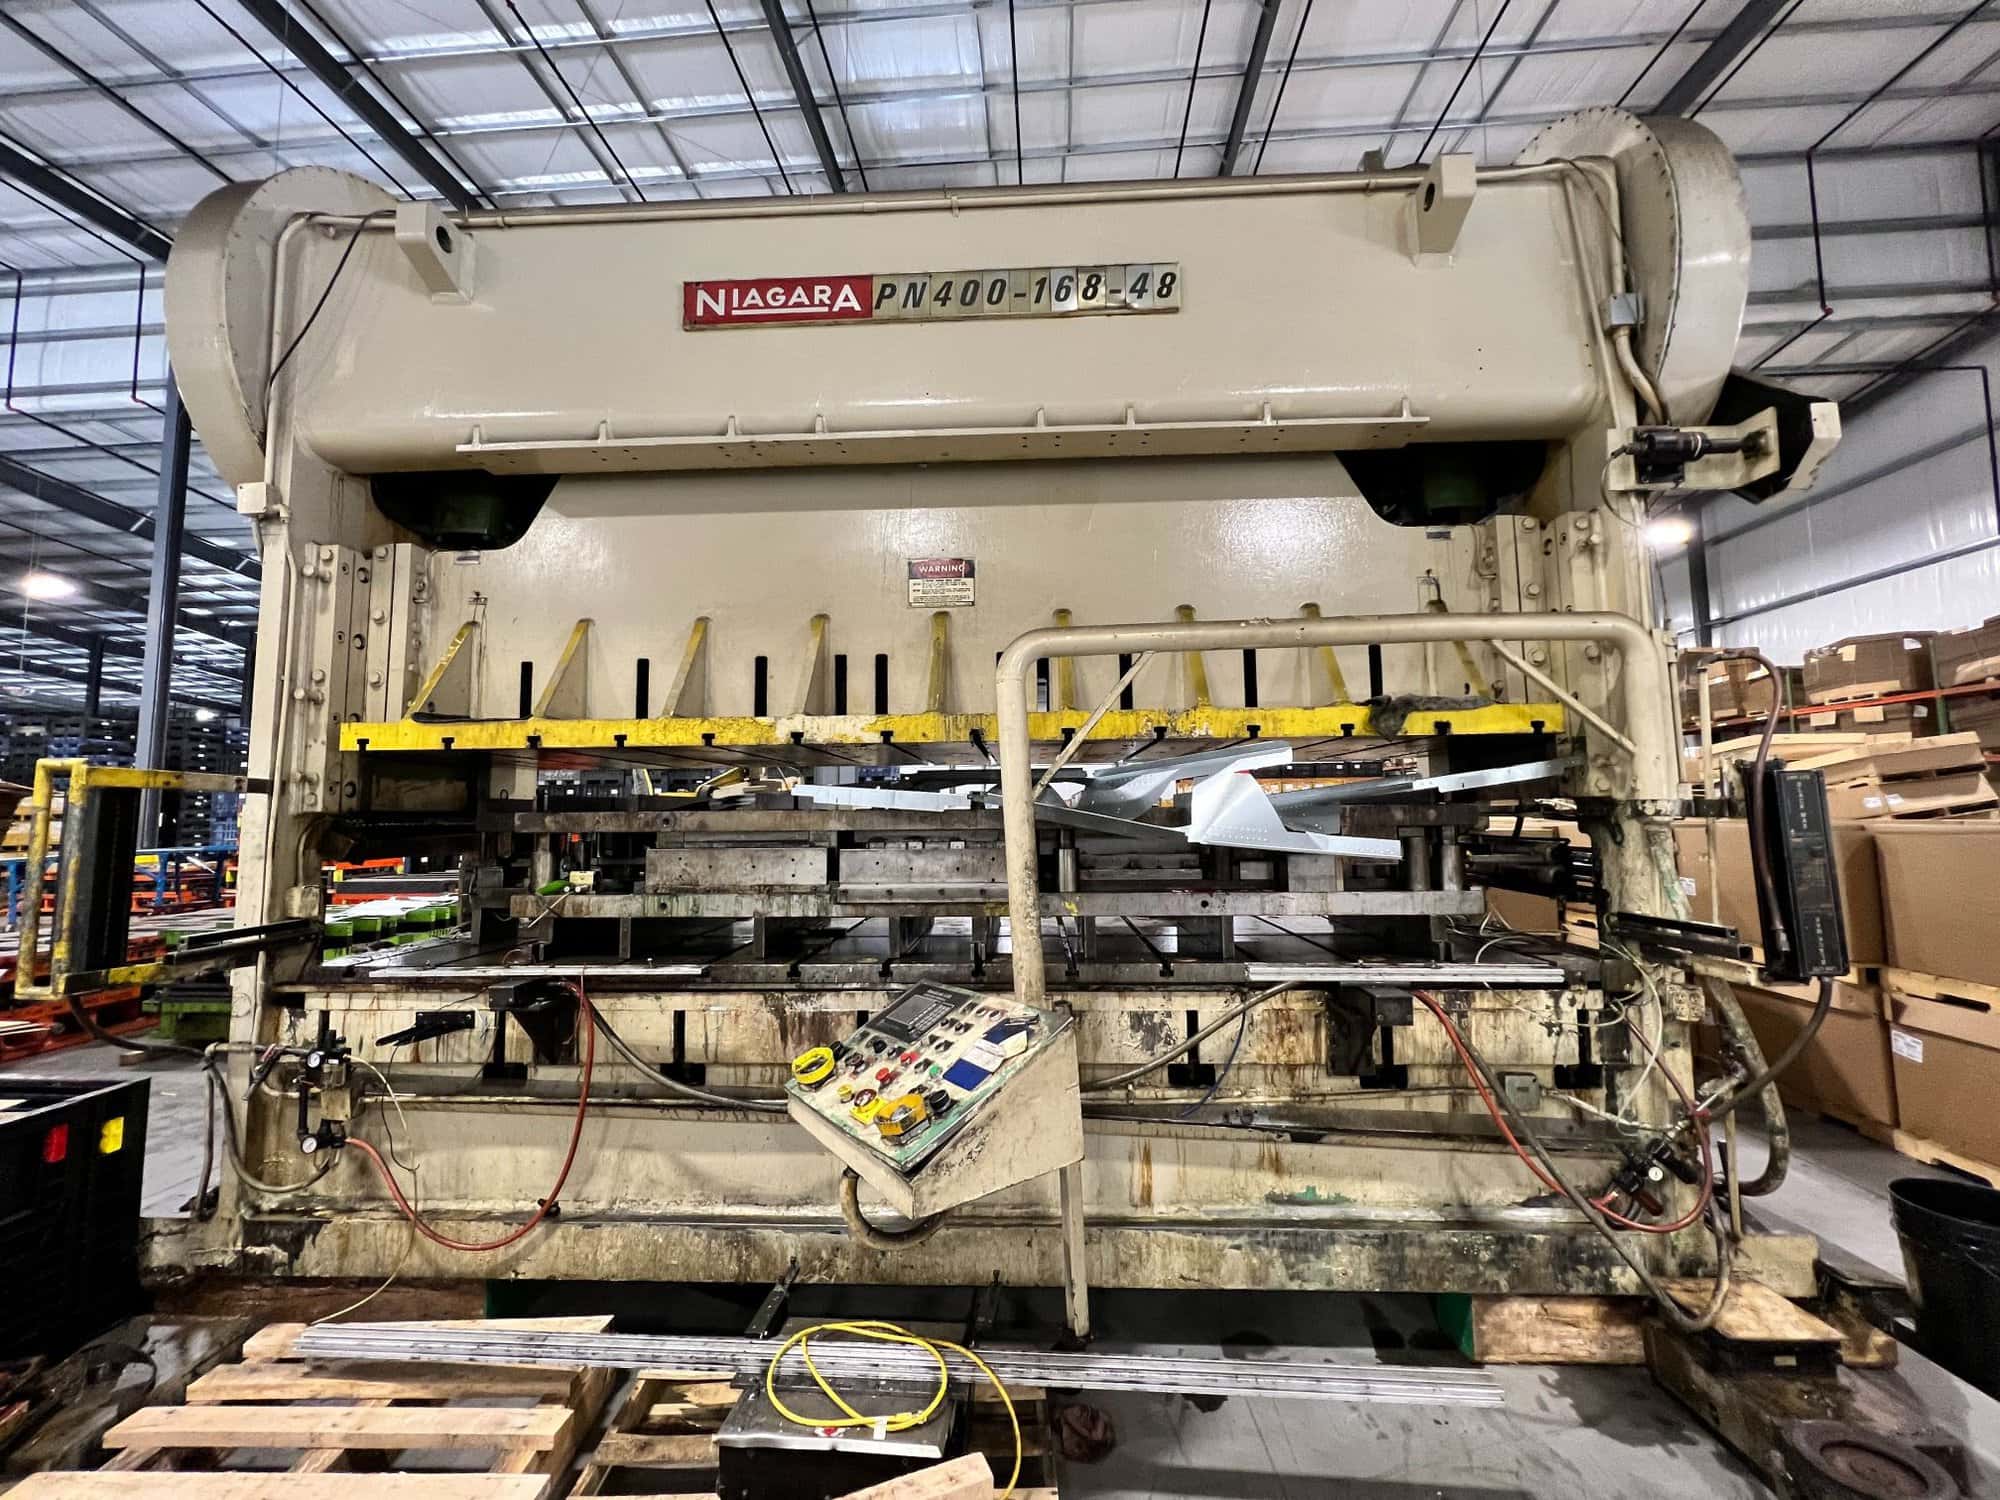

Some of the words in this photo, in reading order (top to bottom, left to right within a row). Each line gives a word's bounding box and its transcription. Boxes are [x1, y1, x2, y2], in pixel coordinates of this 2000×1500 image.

[696, 283, 862, 317] NIAGARA
[874, 271, 1178, 311] PN400-168-48
[919, 564, 965, 574] WARNING
